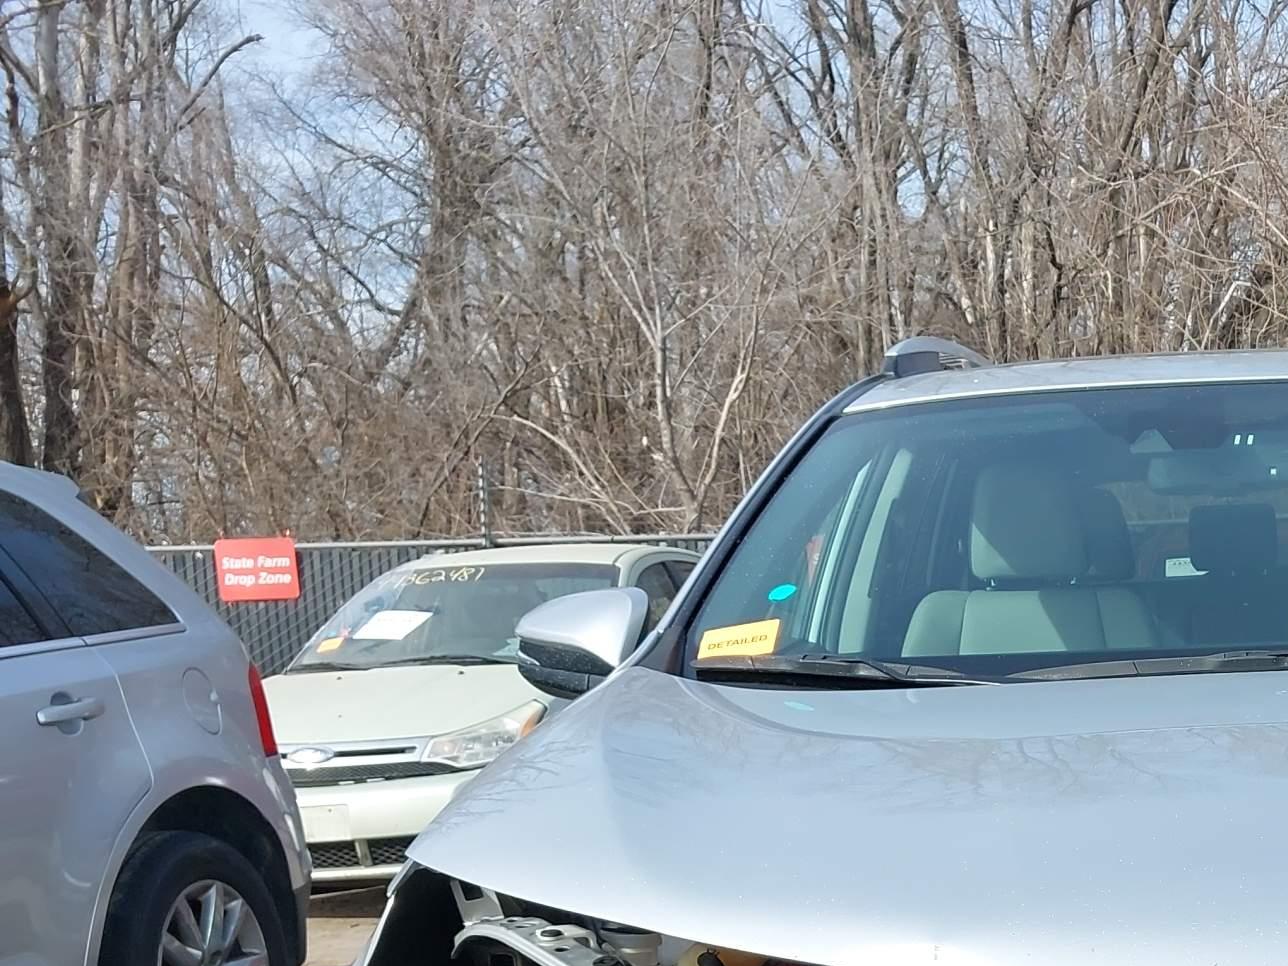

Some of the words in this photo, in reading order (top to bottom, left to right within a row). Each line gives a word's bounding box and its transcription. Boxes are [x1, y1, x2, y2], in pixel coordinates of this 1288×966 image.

[222, 556, 255, 569] State
[256, 555, 290, 568] Farm
[224, 573, 256, 587] Drop
[257, 571, 292, 585] Zone
[707, 634, 769, 650] DETAILED
